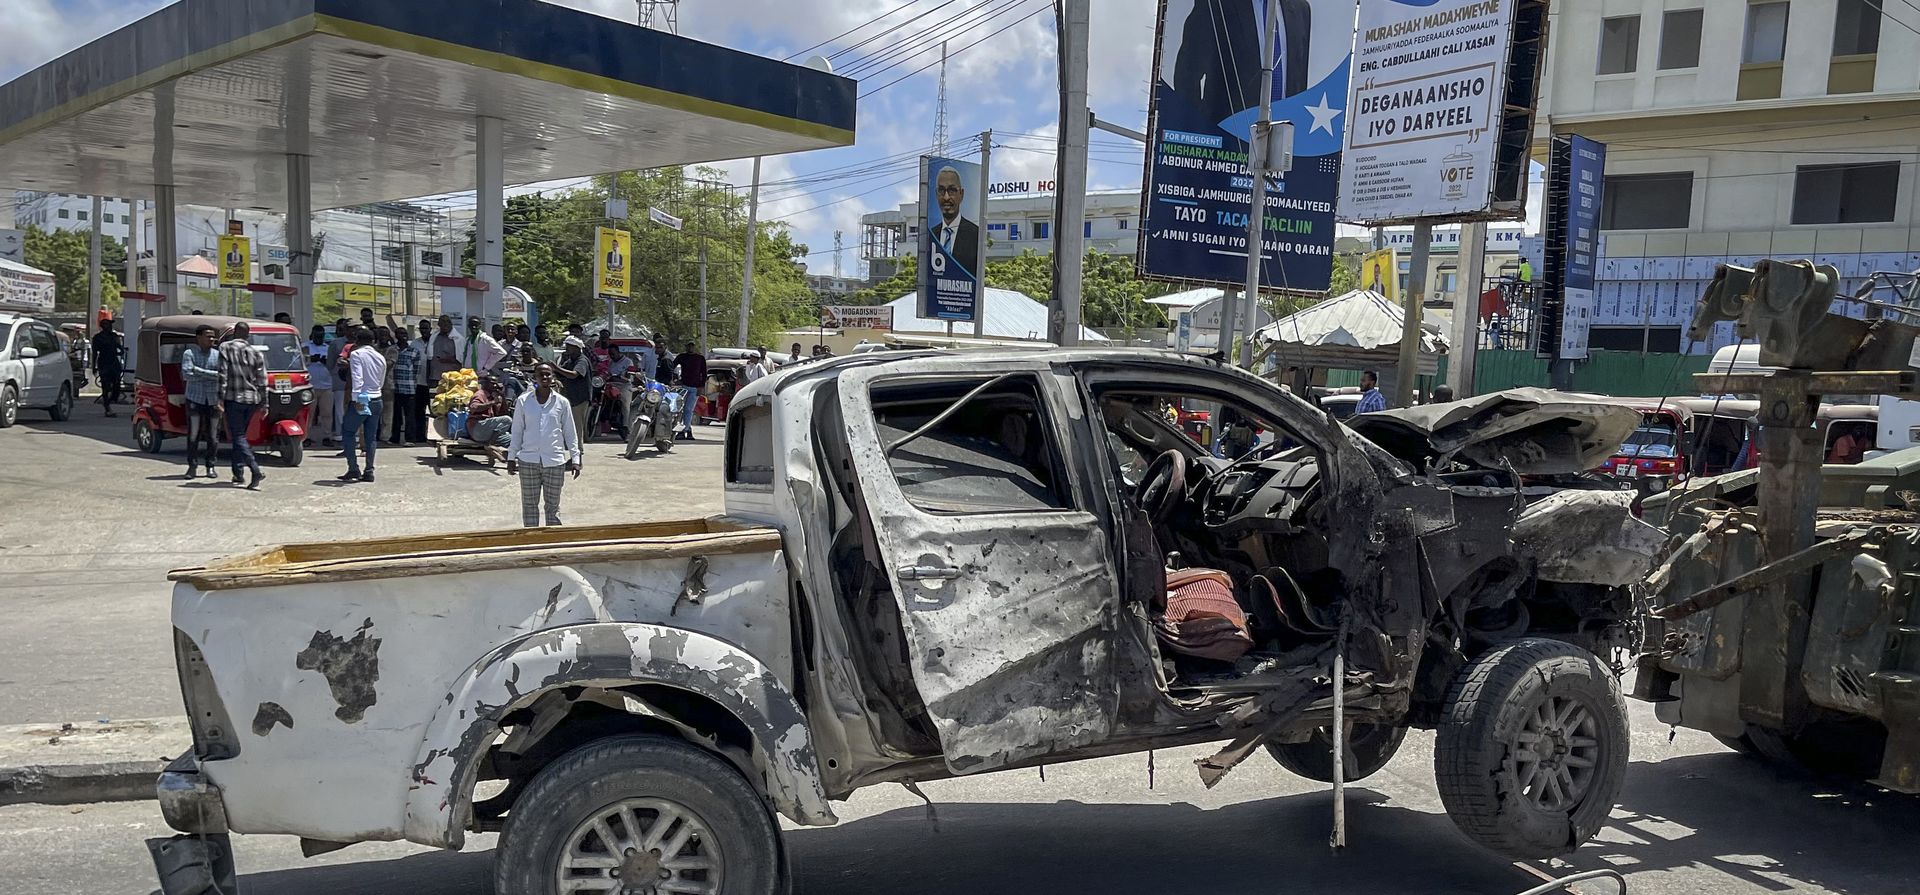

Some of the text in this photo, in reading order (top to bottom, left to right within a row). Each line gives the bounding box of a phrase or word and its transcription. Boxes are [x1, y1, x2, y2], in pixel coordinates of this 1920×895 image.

[1365, 0, 1499, 43] MURASHAX MADAXWEYNE
[1362, 19, 1499, 56] JAMHUURIYADDA FEDERAALKA SOOMAALIYA
[1360, 35, 1496, 72] ENG. CABDULLAAHI CALI XASAN
[1361, 78, 1485, 115] DEGANAANSHO
[1368, 106, 1473, 138] IYO DARYEEL
[1164, 132, 1221, 146] FOR PRESIDENT
[1163, 144, 1249, 163] MUSHARAX MADAX
[1162, 155, 1203, 170] ABDINUR
[1205, 160, 1237, 174] AHMED
[1440, 167, 1474, 183] VOTE
[989, 182, 1029, 194] ADISHU
[1158, 184, 1195, 198] XISBIGA
[1197, 188, 1252, 204] JAMHUURIG
[1175, 206, 1313, 235] TAYO TACA TACLIIN
[1163, 229, 1189, 242] AMNI
[1192, 233, 1225, 246] SUGAN
[1229, 236, 1246, 248] IYO
[1295, 244, 1330, 256] QARAN
[1391, 234, 1443, 243] AFRN
[1496, 232, 1522, 242] KM4
[936, 278, 973, 293] MURASHAX
[842, 308, 878, 316] MOGADISHU
